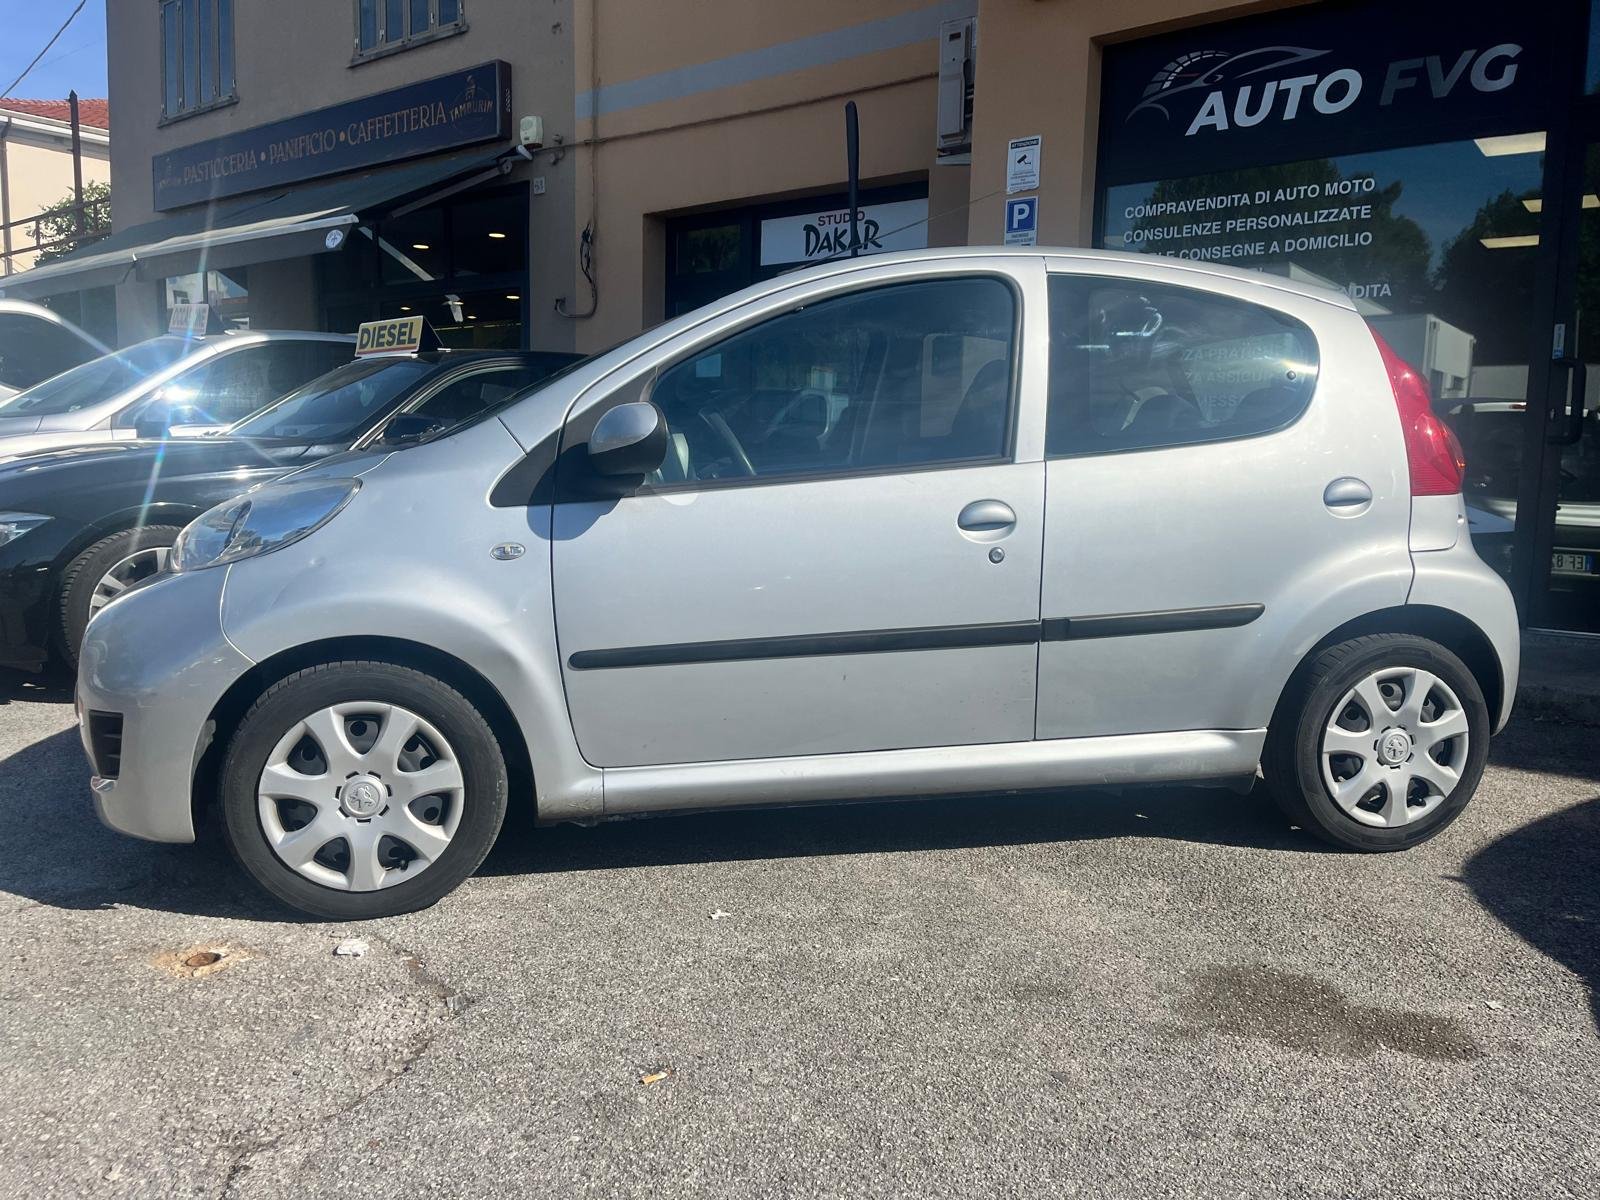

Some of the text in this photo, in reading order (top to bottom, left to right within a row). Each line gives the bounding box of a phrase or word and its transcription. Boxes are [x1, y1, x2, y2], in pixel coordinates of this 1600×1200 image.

[1185, 43, 1523, 136] AUTO FVG
[183, 150, 258, 185] PASTICCERIA
[268, 128, 337, 165] PANIFICIO
[347, 101, 448, 146] CAFFETTERIA
[1124, 177, 1376, 219] COMPRAVENDITA DI AUTO MOTO
[817, 210, 866, 227] STUDO
[1012, 203, 1030, 229] P
[1123, 204, 1372, 244] CONSULENZE PERSONALIZZATE
[1180, 242, 1265, 260] CONSEGNE
[1268, 241, 1280, 255] A
[1284, 231, 1373, 253] DOMICILIO
[1340, 283, 1392, 299] NDITA
[358, 321, 417, 350] DIESEL
